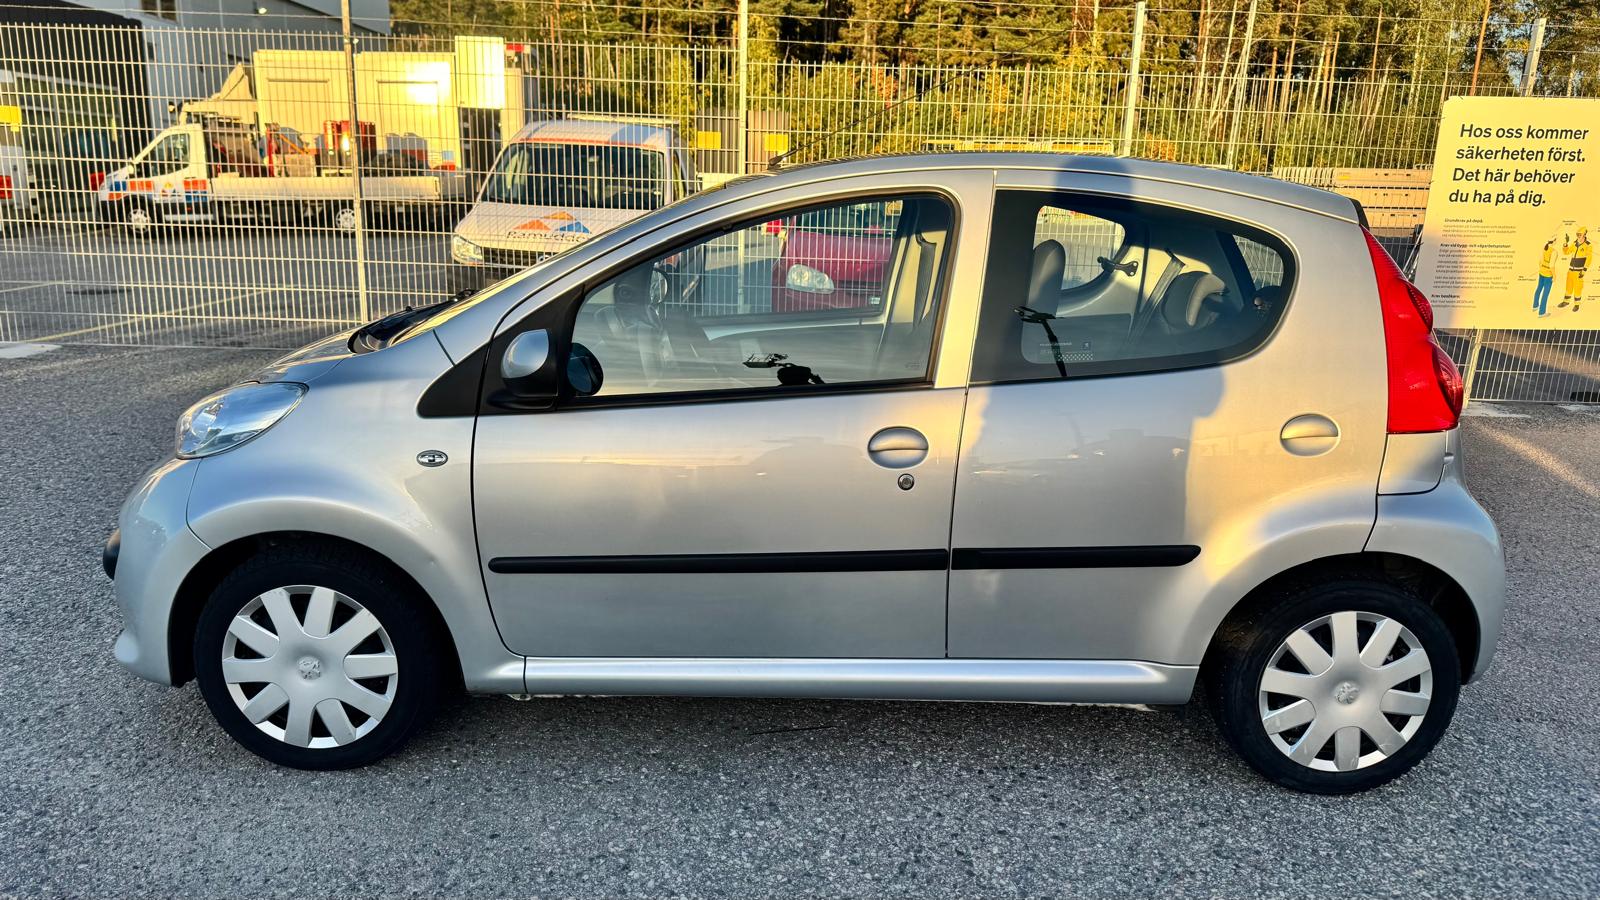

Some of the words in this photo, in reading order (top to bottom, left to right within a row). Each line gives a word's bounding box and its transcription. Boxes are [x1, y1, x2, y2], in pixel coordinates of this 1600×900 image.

[1460, 123, 1492, 139] Hos
[1495, 126, 1523, 140] oss
[1526, 124, 1590, 140] kommer
[1455, 146, 1545, 161] säkerheten
[1547, 147, 1586, 162] först.
[1452, 167, 1481, 182] Det
[1483, 168, 1511, 183] här
[1513, 169, 1576, 183] behöver
[1448, 189, 1469, 203] du
[1472, 189, 1492, 203] ha
[1494, 188, 1515, 207] på
[1518, 190, 1546, 207] dig.
[506, 231, 589, 242] Ramudde
